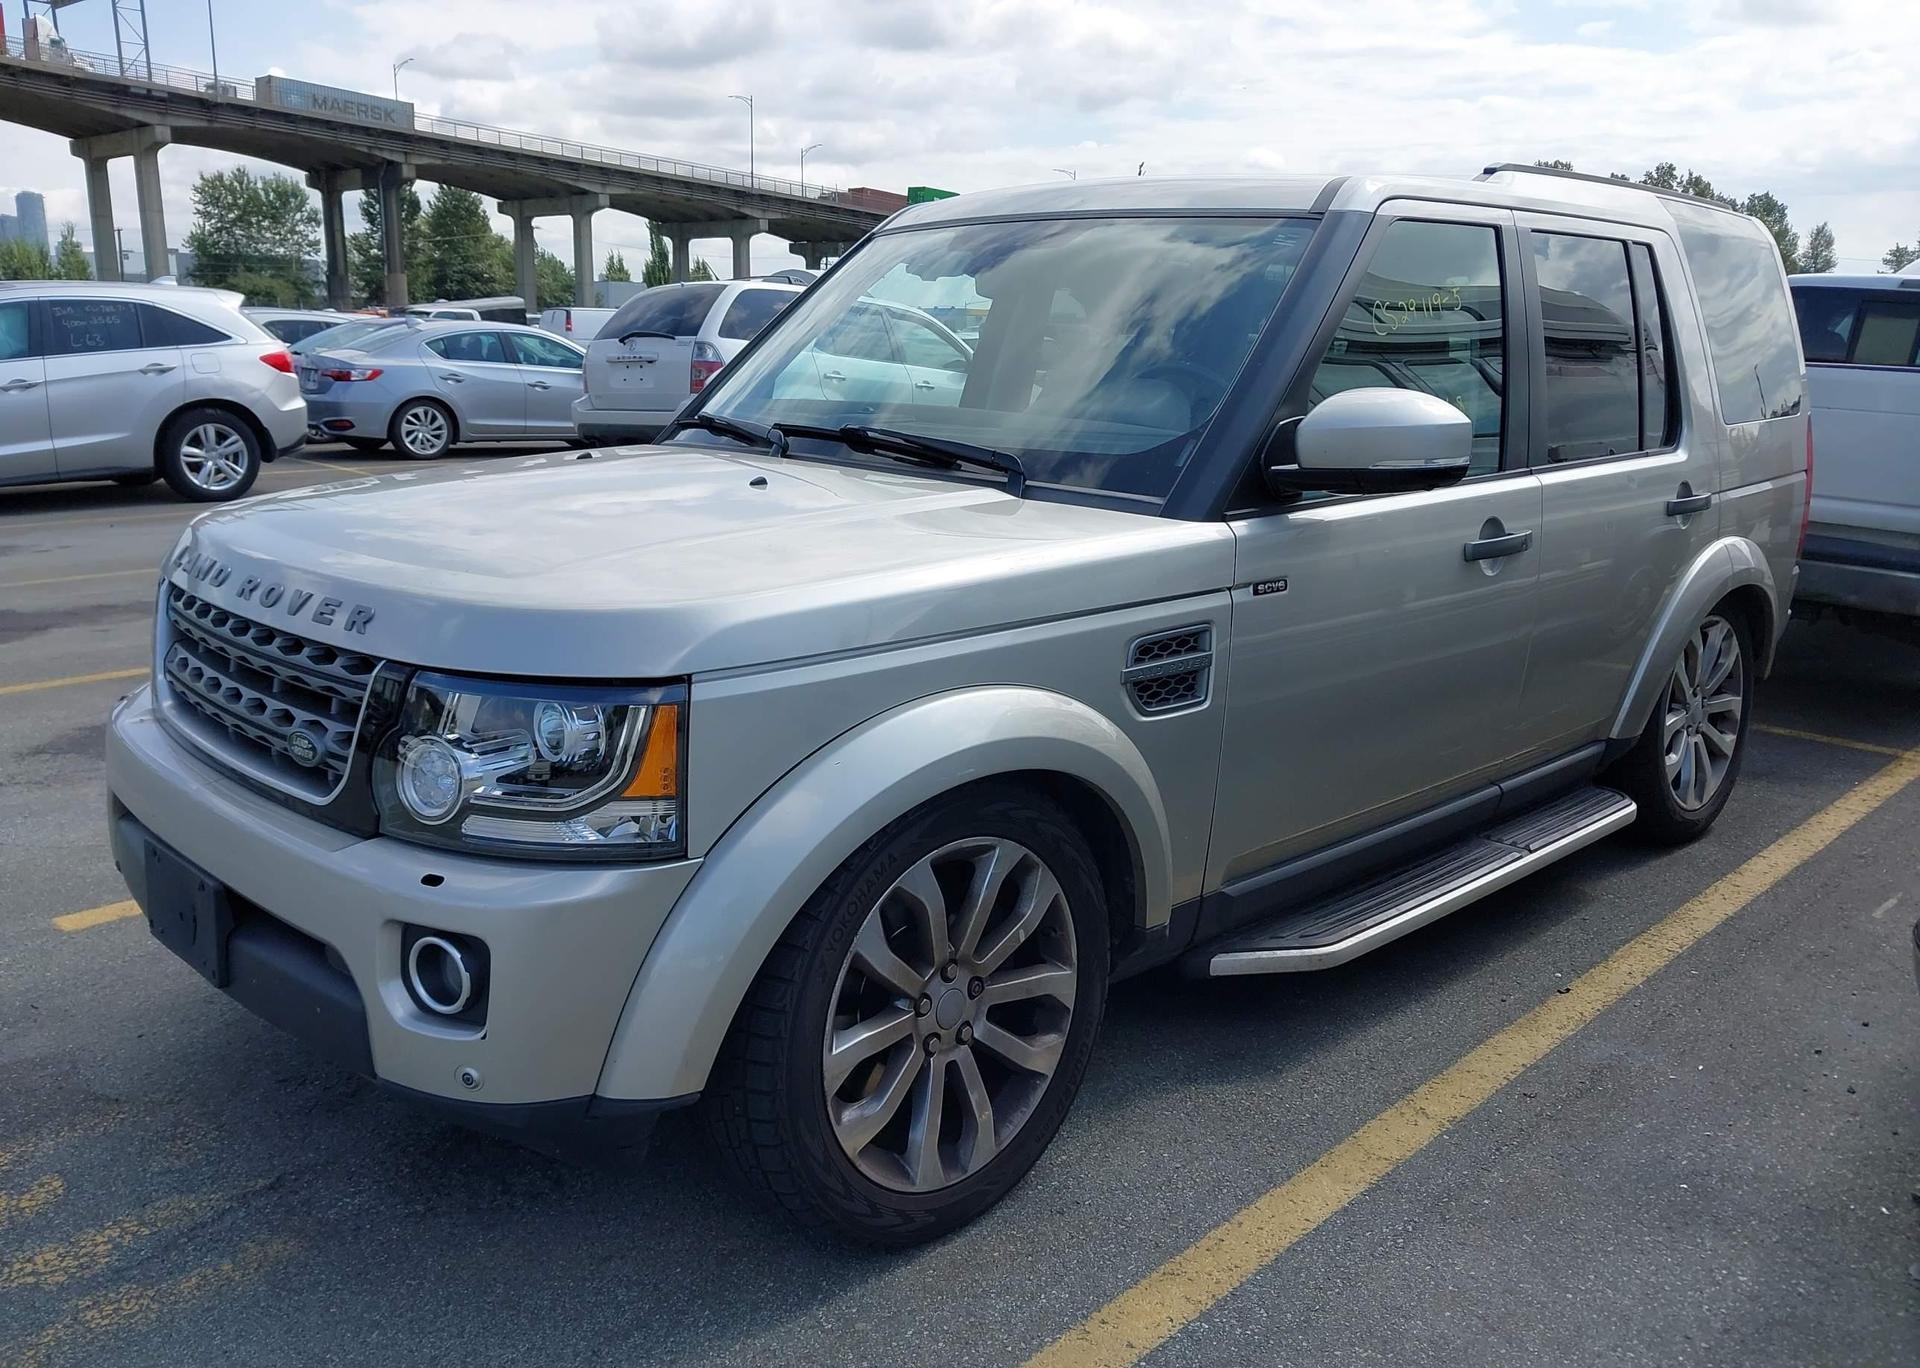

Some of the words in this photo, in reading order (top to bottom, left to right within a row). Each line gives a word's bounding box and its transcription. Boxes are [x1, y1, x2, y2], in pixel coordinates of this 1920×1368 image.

[312, 94, 397, 124] MAERSK
[173, 546, 233, 588] LAND
[235, 574, 376, 635] ROVER
[824, 852, 899, 953] YOKOHAMA
